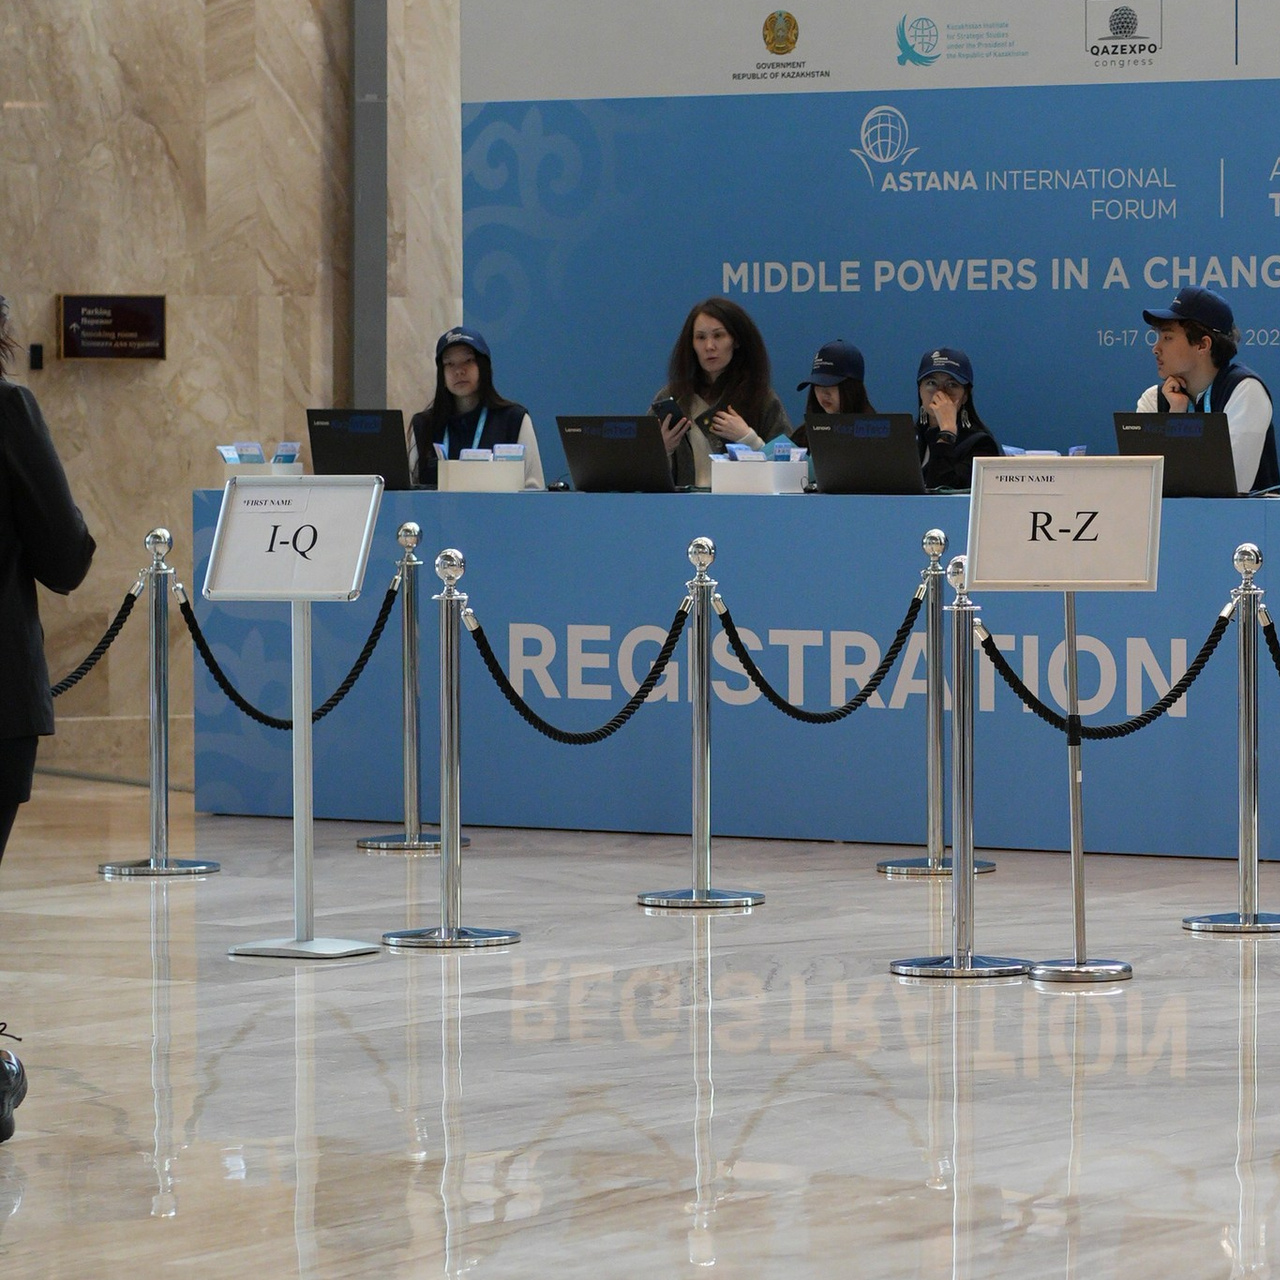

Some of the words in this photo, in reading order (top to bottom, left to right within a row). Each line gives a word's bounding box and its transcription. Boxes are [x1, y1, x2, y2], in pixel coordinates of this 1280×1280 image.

[1090, 43, 1157, 56] QAZEXPO
[756, 61, 806, 69] GOVERNMENT
[1094, 58, 1154, 68] congress
[781, 70, 830, 78] KAZAKHSTAN
[881, 171, 978, 192] ASTANA
[986, 168, 1176, 190] INTERNATIONAL
[1092, 199, 1177, 219] FORUM
[722, 261, 861, 293] MIDDLE
[875, 258, 1037, 291] POWERS
[1052, 258, 1088, 289] IN
[1103, 258, 1130, 289] A
[81, 308, 112, 317] Parking
[1097, 329, 1138, 346] 16-17
[1028, 475, 1055, 483] NAME
[1027, 511, 1099, 542] R-Z
[265, 524, 318, 560] I-Q
[508, 623, 1189, 718] REGSTRATION
